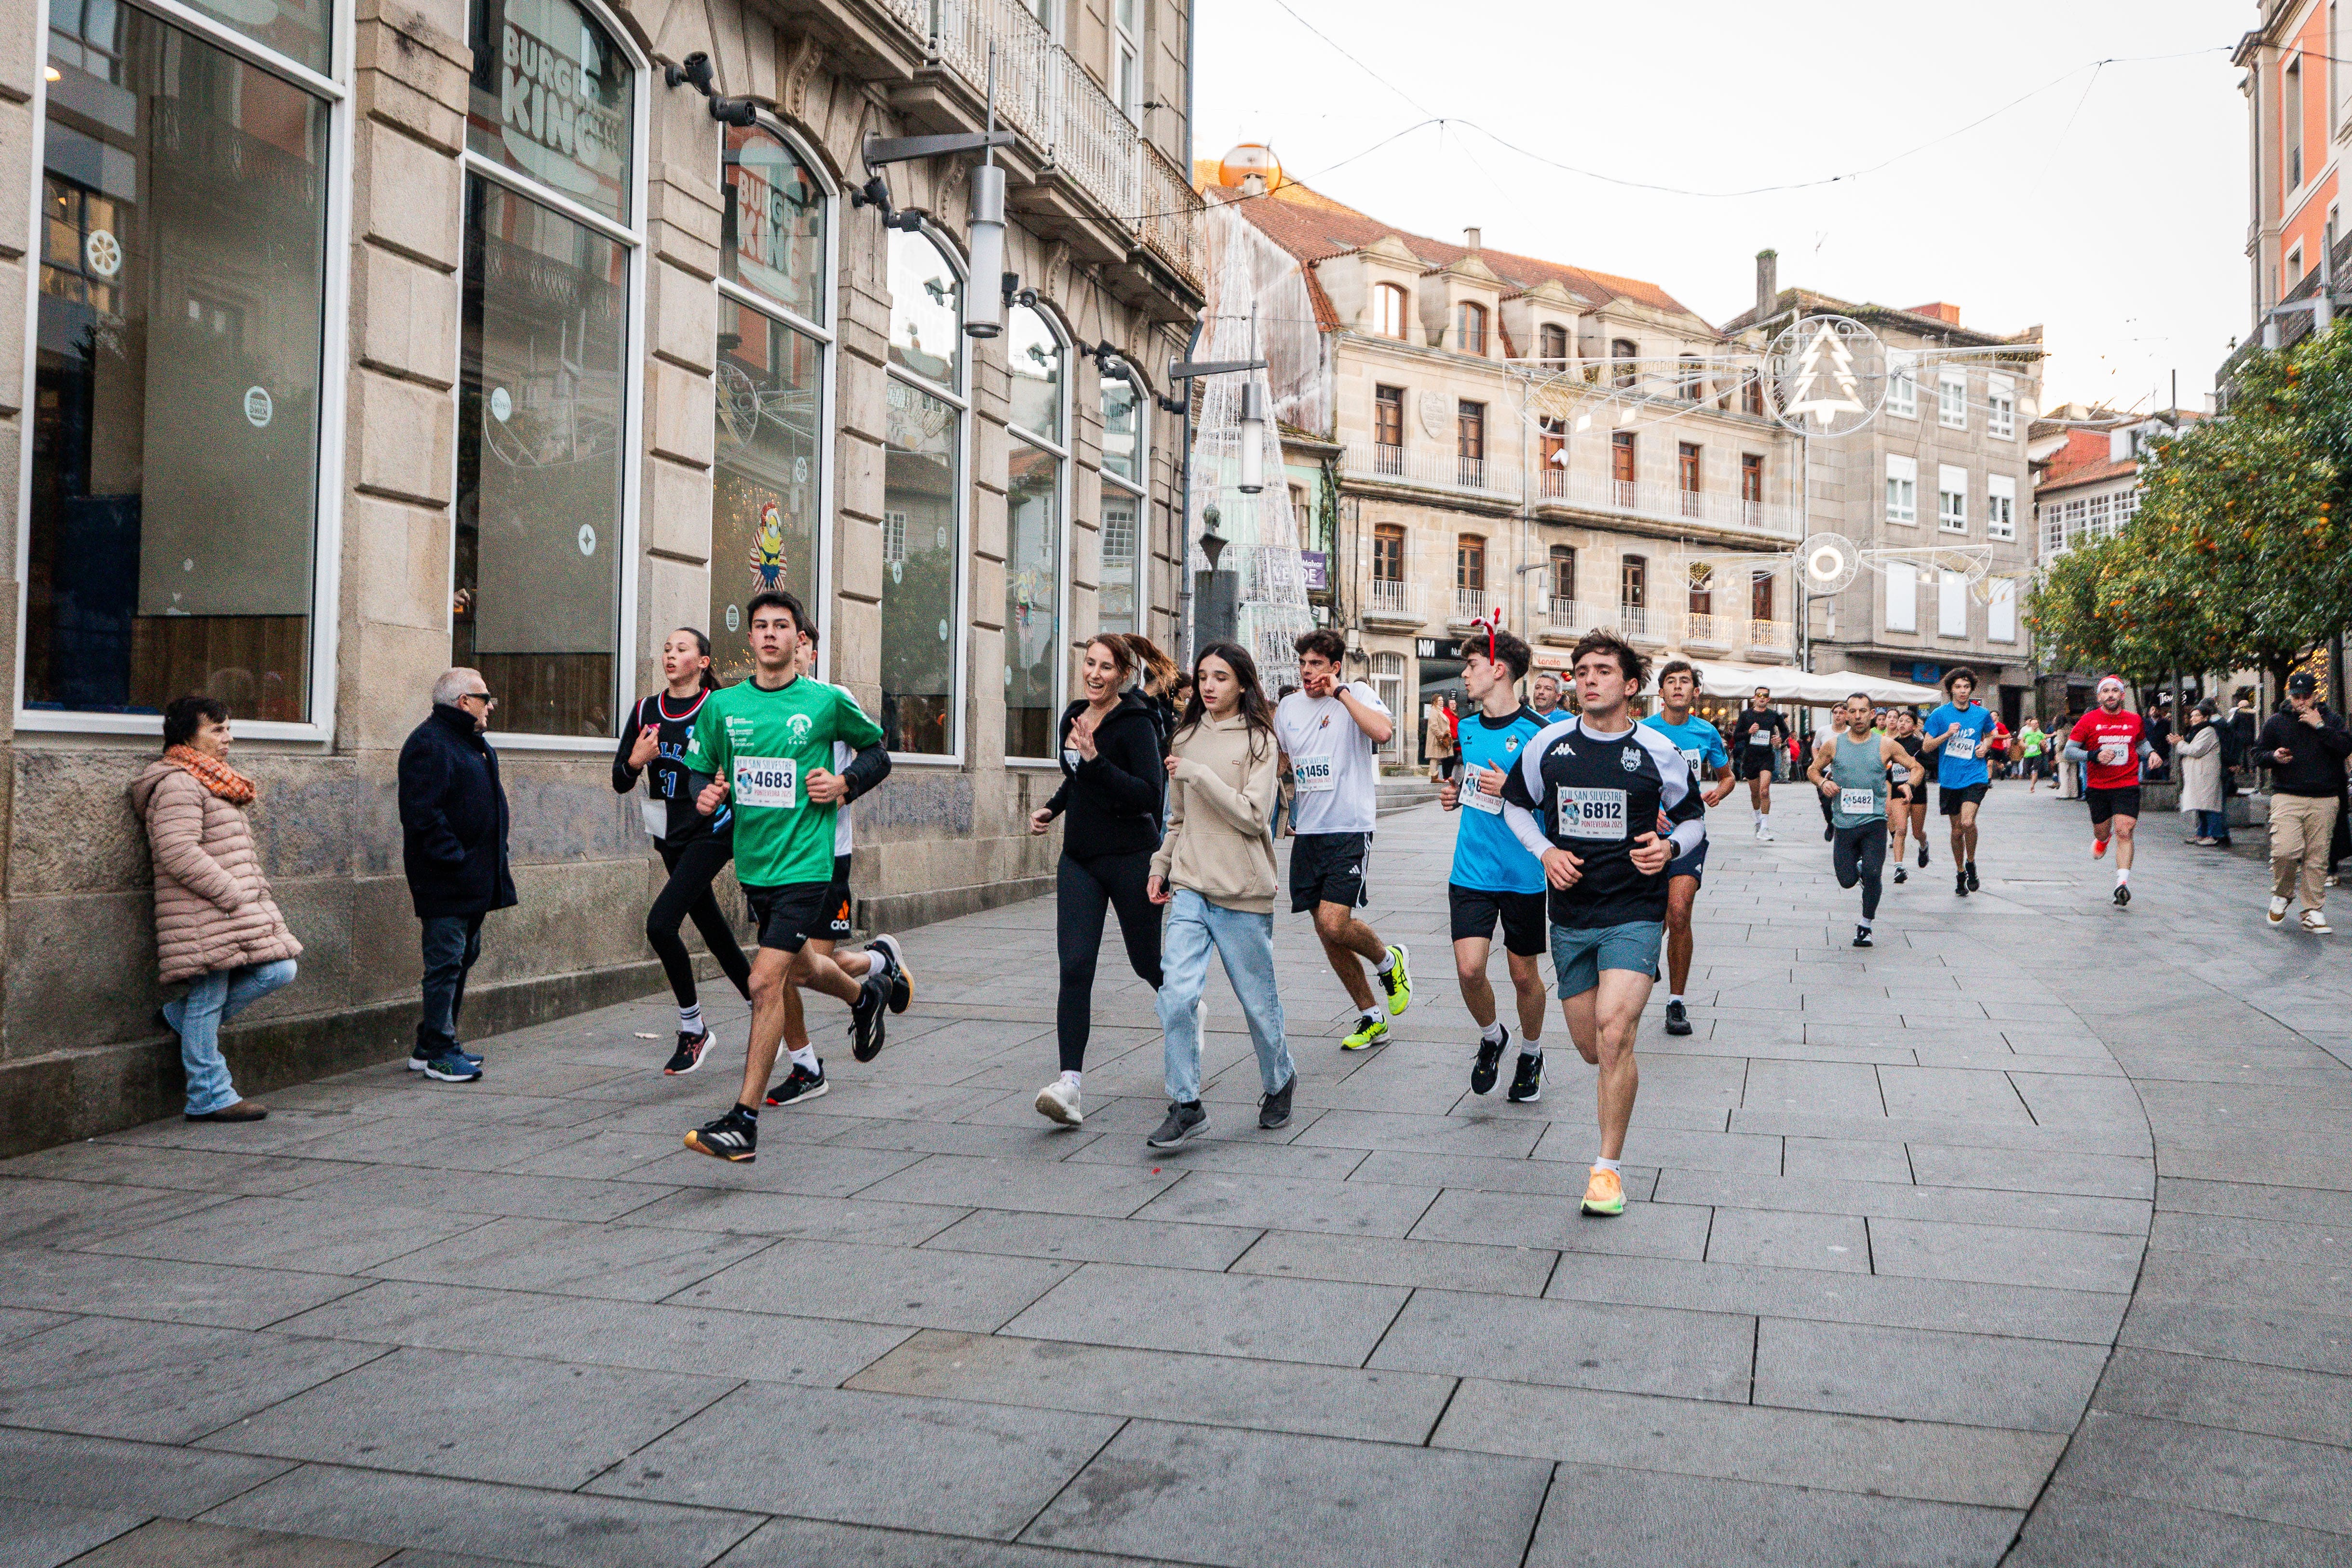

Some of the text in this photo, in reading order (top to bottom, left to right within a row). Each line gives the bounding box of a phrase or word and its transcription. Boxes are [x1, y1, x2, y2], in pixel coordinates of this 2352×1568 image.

[502, 65, 600, 167] KING
[763, 760, 792, 770] SILVESTRE
[1306, 764, 1329, 777] 1456
[755, 771, 792, 788] 4683
[1574, 790, 1588, 800] SAN
[1590, 790, 1622, 801] SILVESTRE
[1852, 795, 1872, 804] 5482
[1583, 802, 1622, 819] 6812
